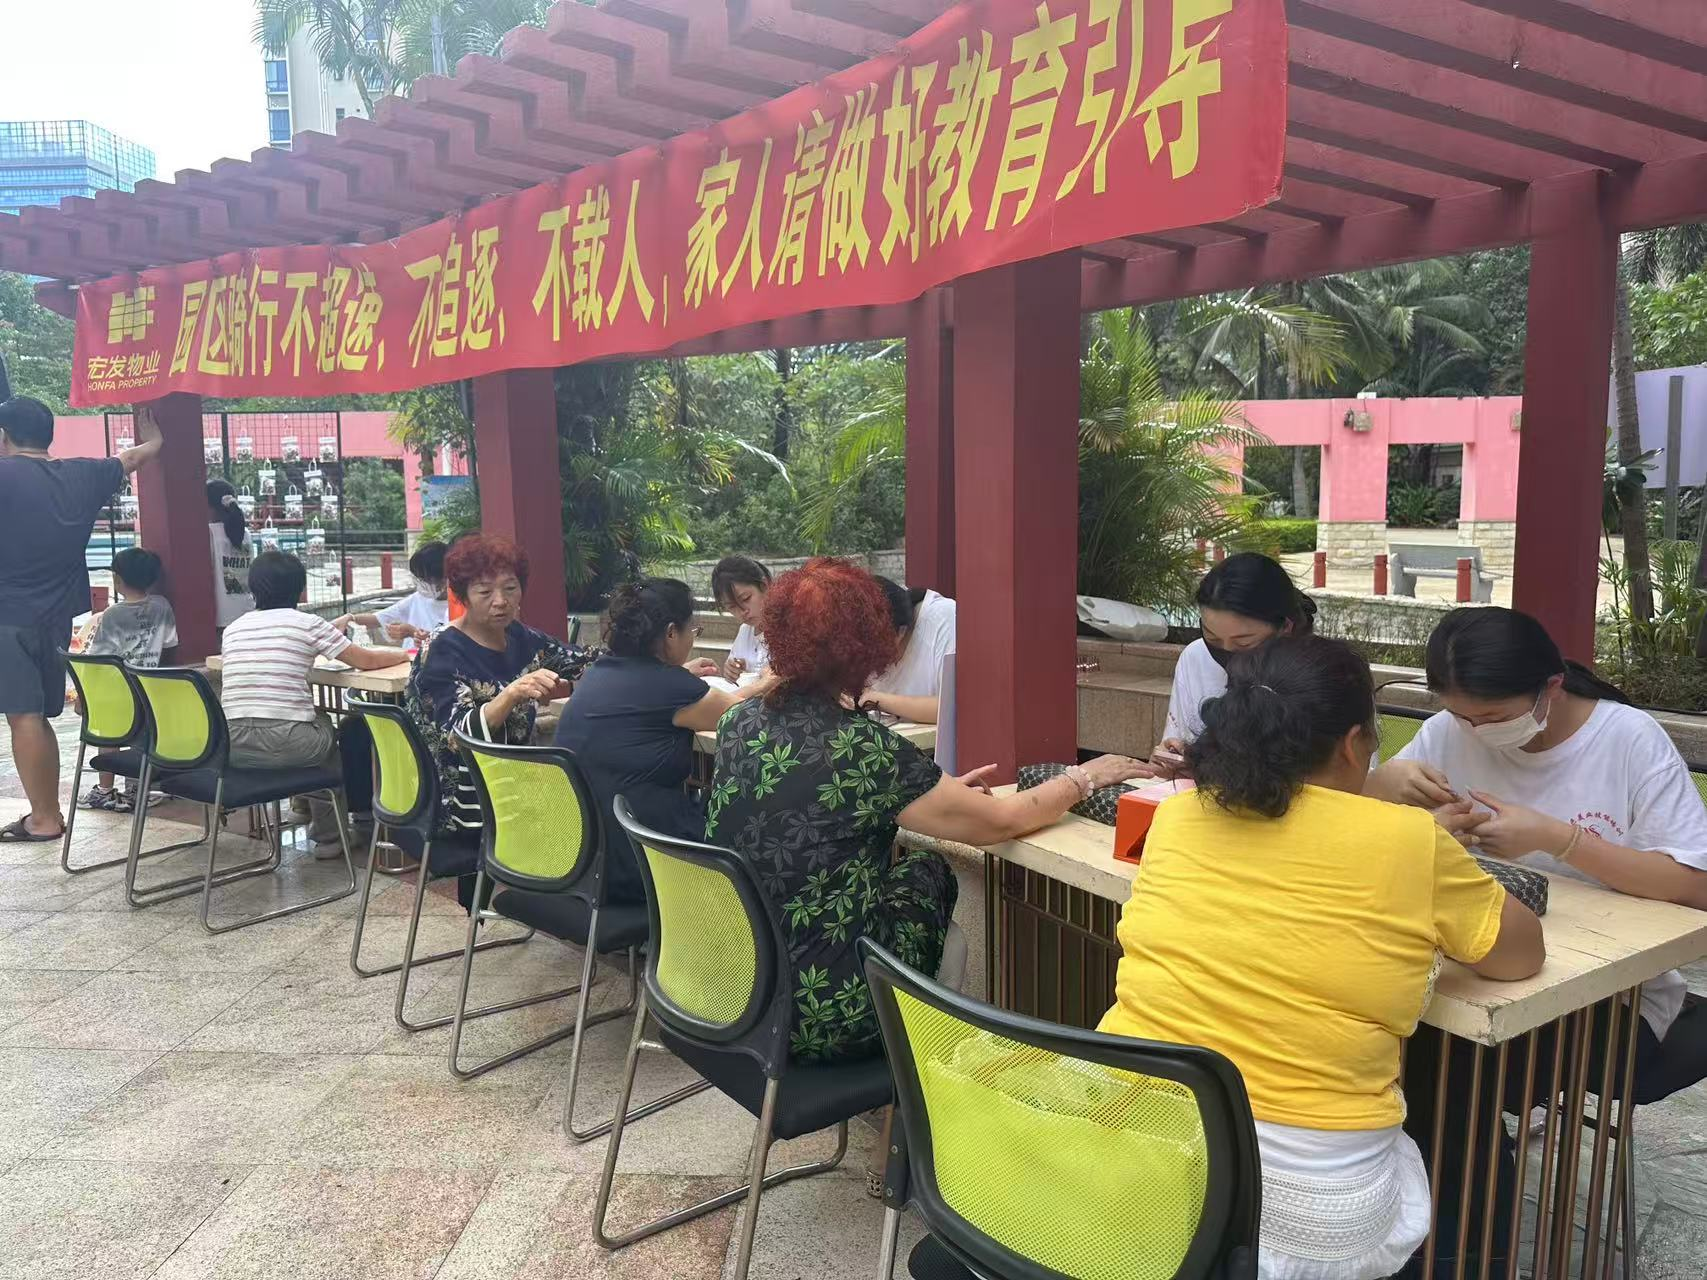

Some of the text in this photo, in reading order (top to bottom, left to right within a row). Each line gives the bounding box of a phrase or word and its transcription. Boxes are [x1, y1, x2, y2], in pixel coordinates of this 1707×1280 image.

[87, 350, 161, 380] 宏发物业
[87, 375, 158, 392] HONFA PROPERTY
